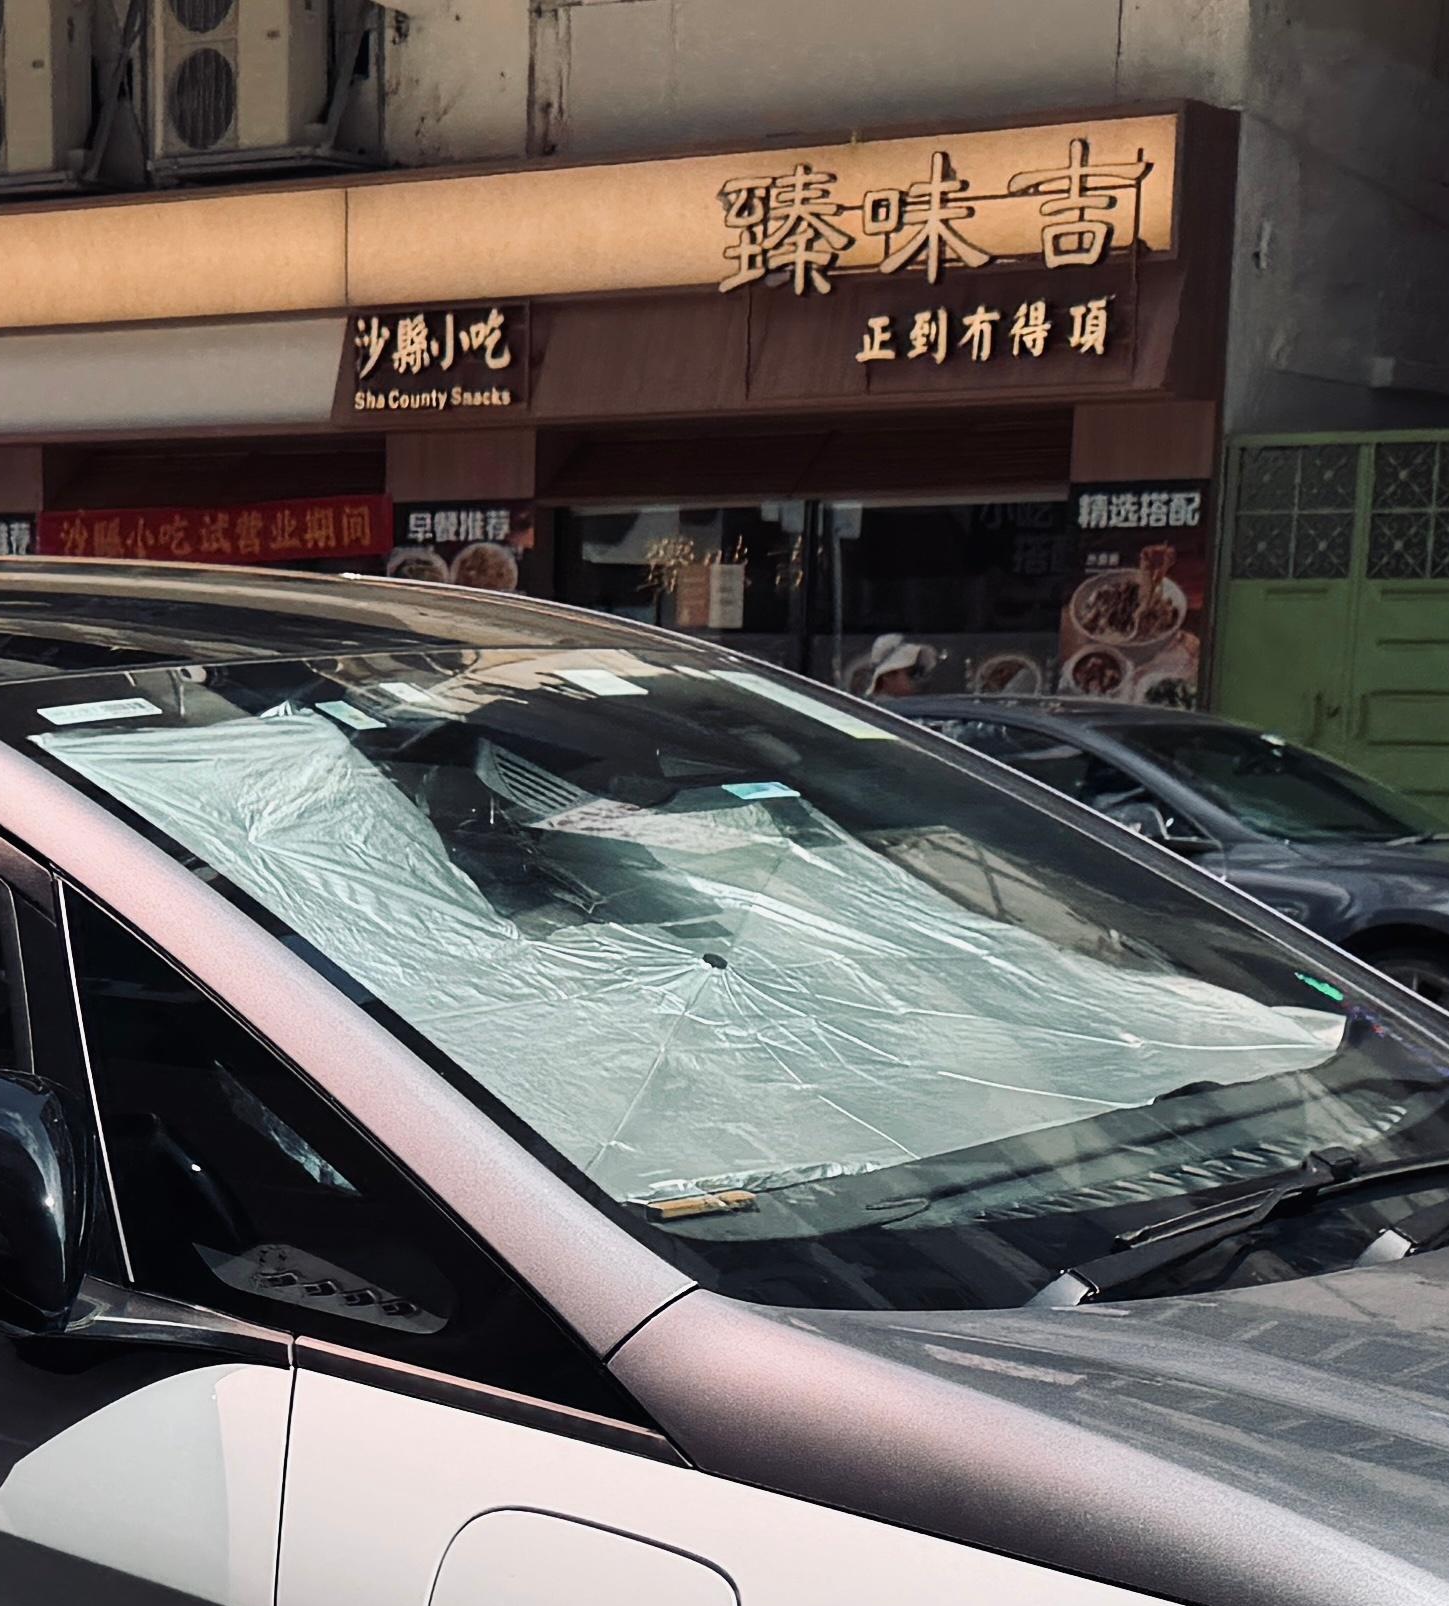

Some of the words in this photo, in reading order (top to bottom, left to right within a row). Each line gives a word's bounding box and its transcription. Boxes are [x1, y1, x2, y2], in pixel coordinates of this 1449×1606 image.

[355, 308, 511, 379] 沙縣小吃
[855, 296, 1114, 364] 正到冇得頂
[354, 390, 386, 410] Sha
[388, 388, 448, 411] County
[451, 385, 511, 406] Snacks
